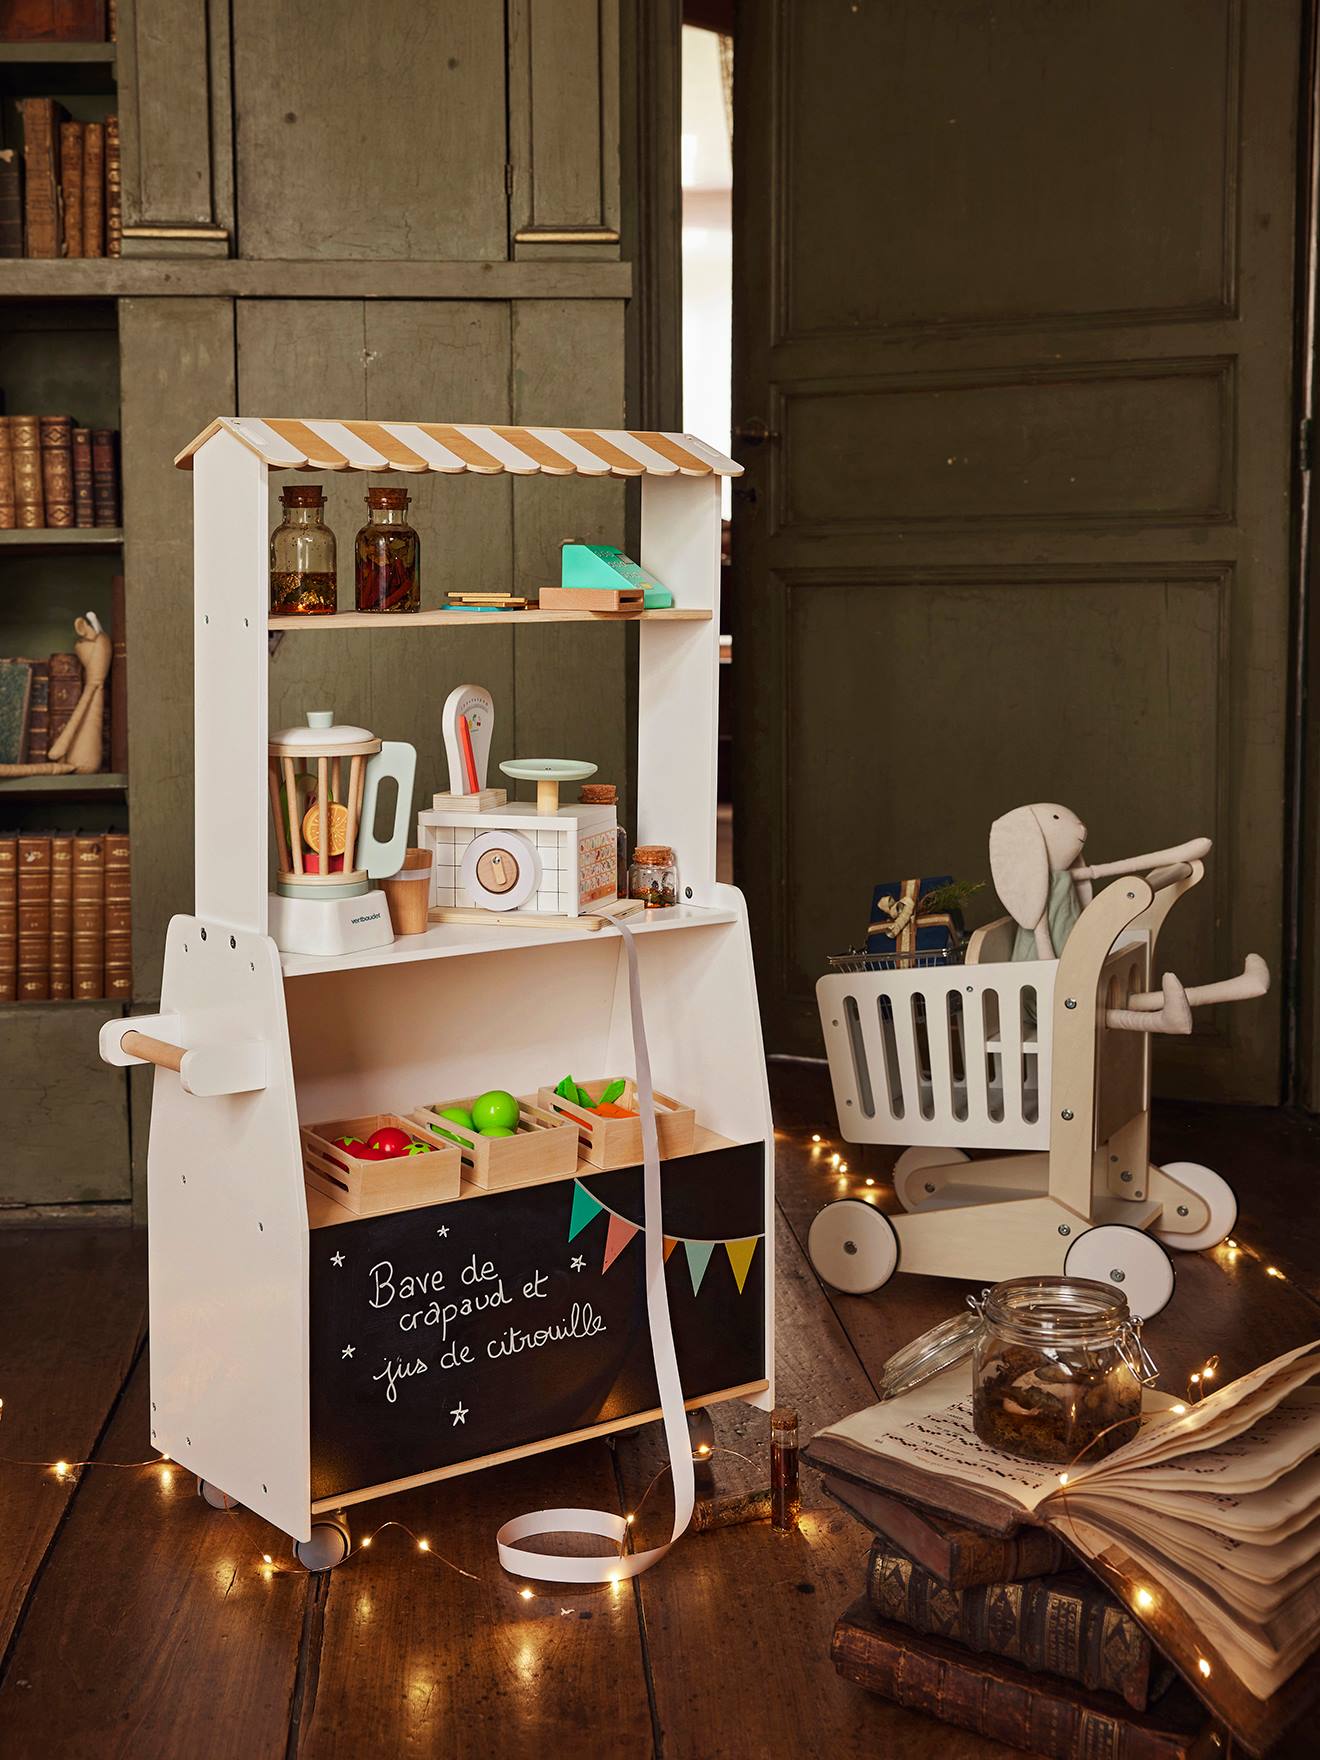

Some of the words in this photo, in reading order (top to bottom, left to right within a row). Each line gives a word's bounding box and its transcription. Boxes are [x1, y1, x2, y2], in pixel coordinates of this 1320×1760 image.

[368, 1260, 446, 1309] Bave
[460, 1253, 499, 1285] de
[399, 1278, 513, 1342] crapaud
[522, 1269, 549, 1299] et
[372, 1357, 428, 1403] jus
[440, 1340, 476, 1369] de
[486, 1302, 607, 1359] citrouille
